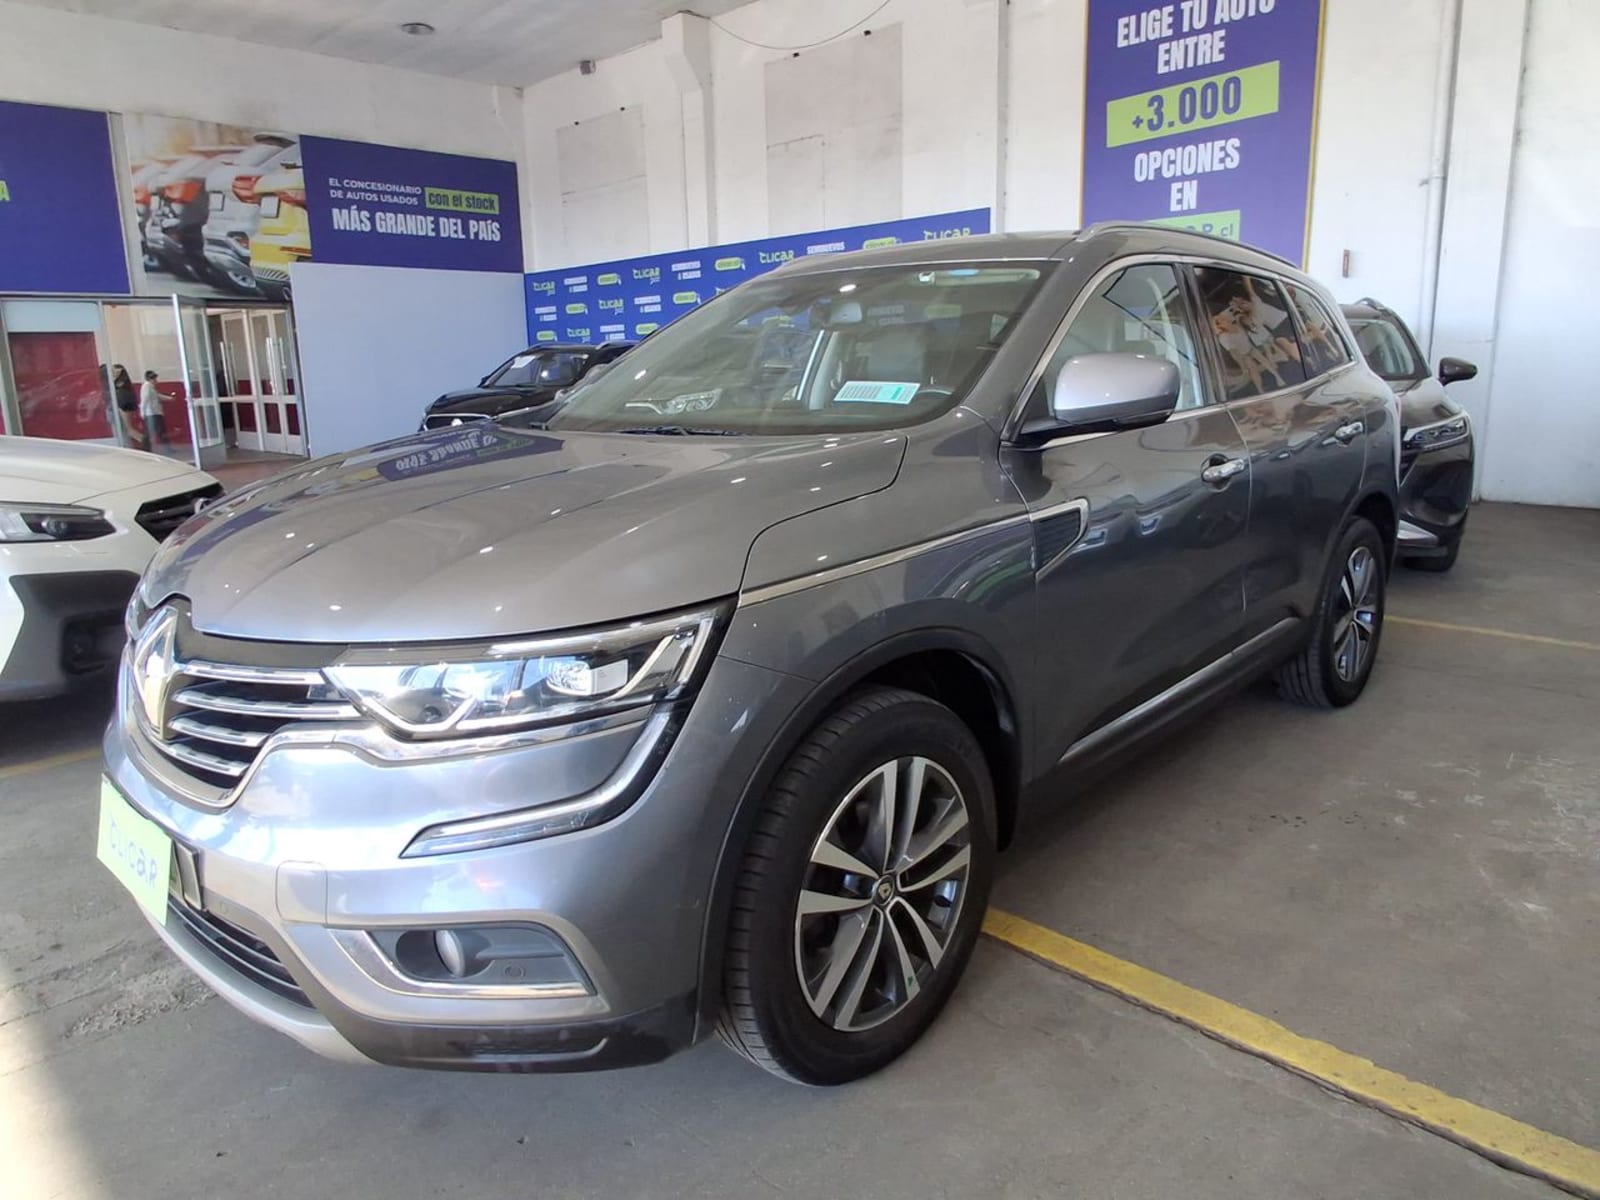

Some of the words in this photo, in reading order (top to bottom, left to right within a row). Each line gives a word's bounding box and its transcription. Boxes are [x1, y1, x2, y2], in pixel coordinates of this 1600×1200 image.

[1117, 6, 1174, 48] ELIGE
[1181, 0, 1208, 33] TU
[1157, 30, 1226, 75] ENTRE
[1132, 76, 1241, 131] +3.000
[1134, 138, 1241, 182] OPCIONES
[329, 177, 342, 187] EL
[343, 179, 422, 195] CONCESIONARIO
[330, 189, 344, 199] DE
[346, 191, 379, 202] AUTOS
[380, 194, 419, 206] USADOS
[429, 192, 450, 207] con
[452, 193, 462, 208] el
[465, 195, 496, 212] stock
[1170, 180, 1198, 212] EN
[332, 205, 372, 232] MÁS
[375, 212, 436, 237] GRANDE
[439, 217, 466, 239] DEL
